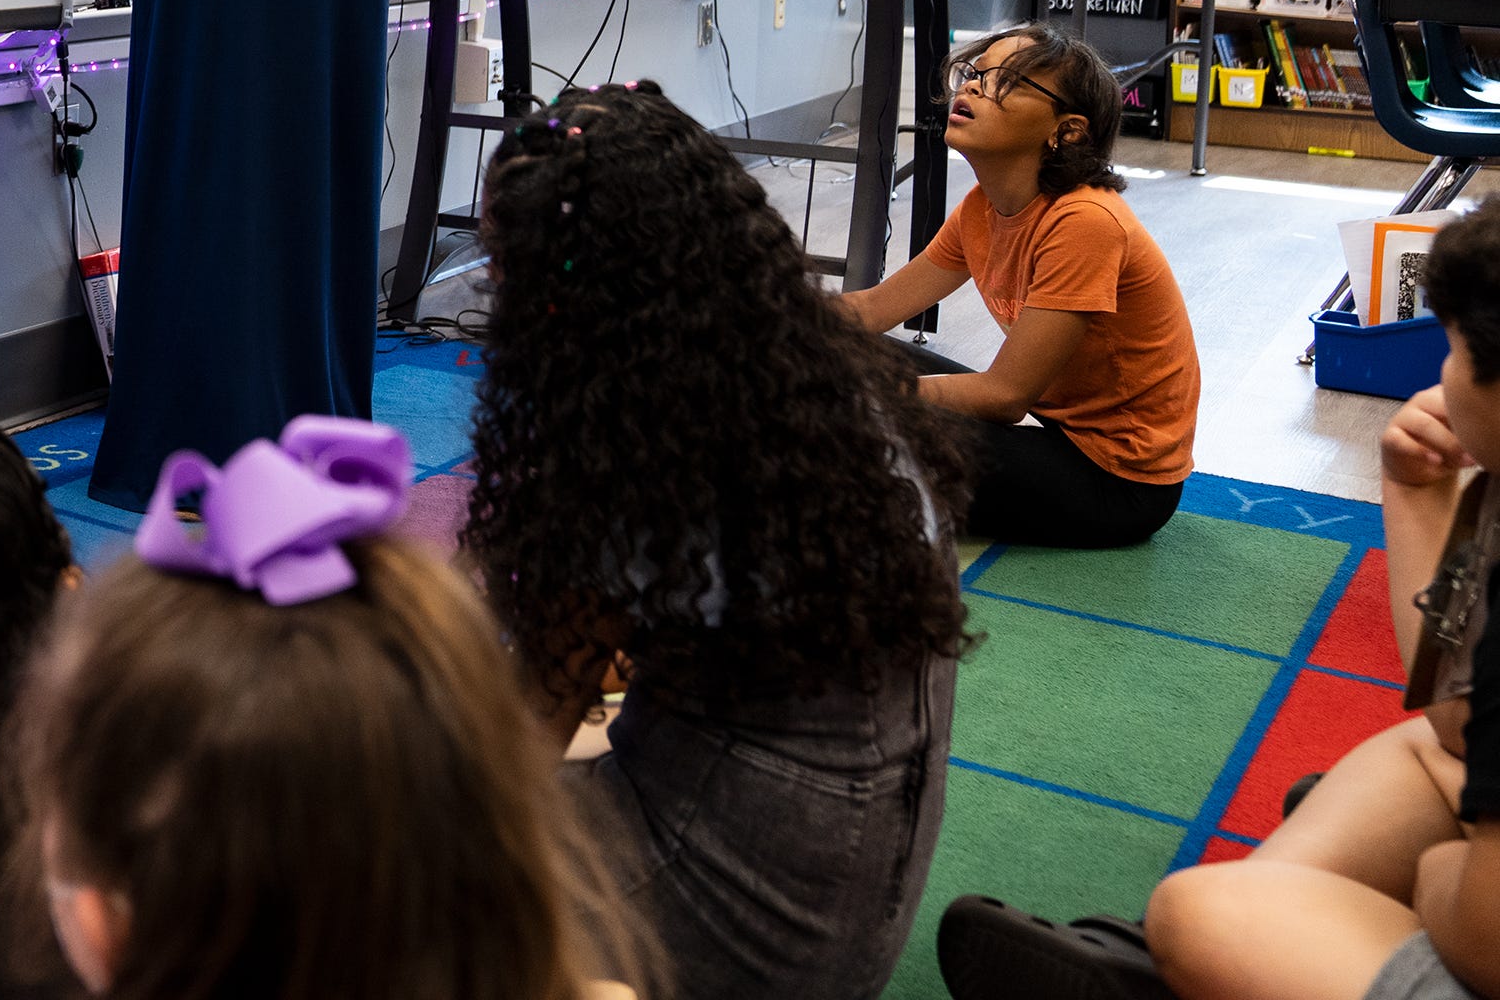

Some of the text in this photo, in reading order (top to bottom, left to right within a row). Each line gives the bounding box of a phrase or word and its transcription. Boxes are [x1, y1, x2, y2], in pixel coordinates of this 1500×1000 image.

[1234, 83, 1244, 96] N
[91, 280, 104, 325] Dictionary
[99, 278, 113, 328] Children's
